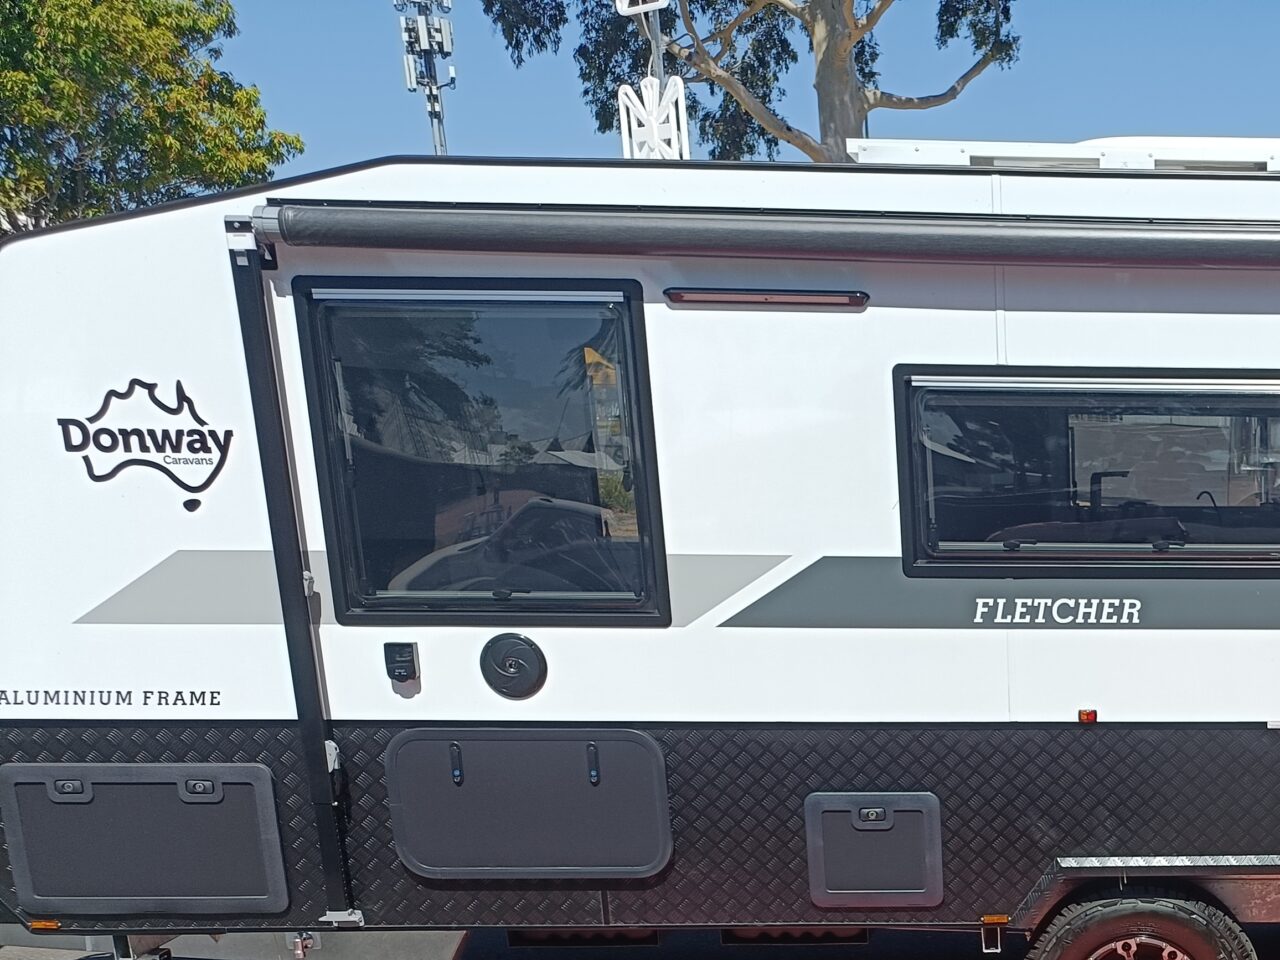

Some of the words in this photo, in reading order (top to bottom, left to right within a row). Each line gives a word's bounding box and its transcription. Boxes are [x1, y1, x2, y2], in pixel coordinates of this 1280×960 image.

[56, 417, 235, 460] Donway
[162, 454, 214, 466] Caravans
[972, 597, 1143, 625] FLETCHER
[0, 689, 134, 706] ALUMINIUM
[141, 690, 222, 707] FRAME
